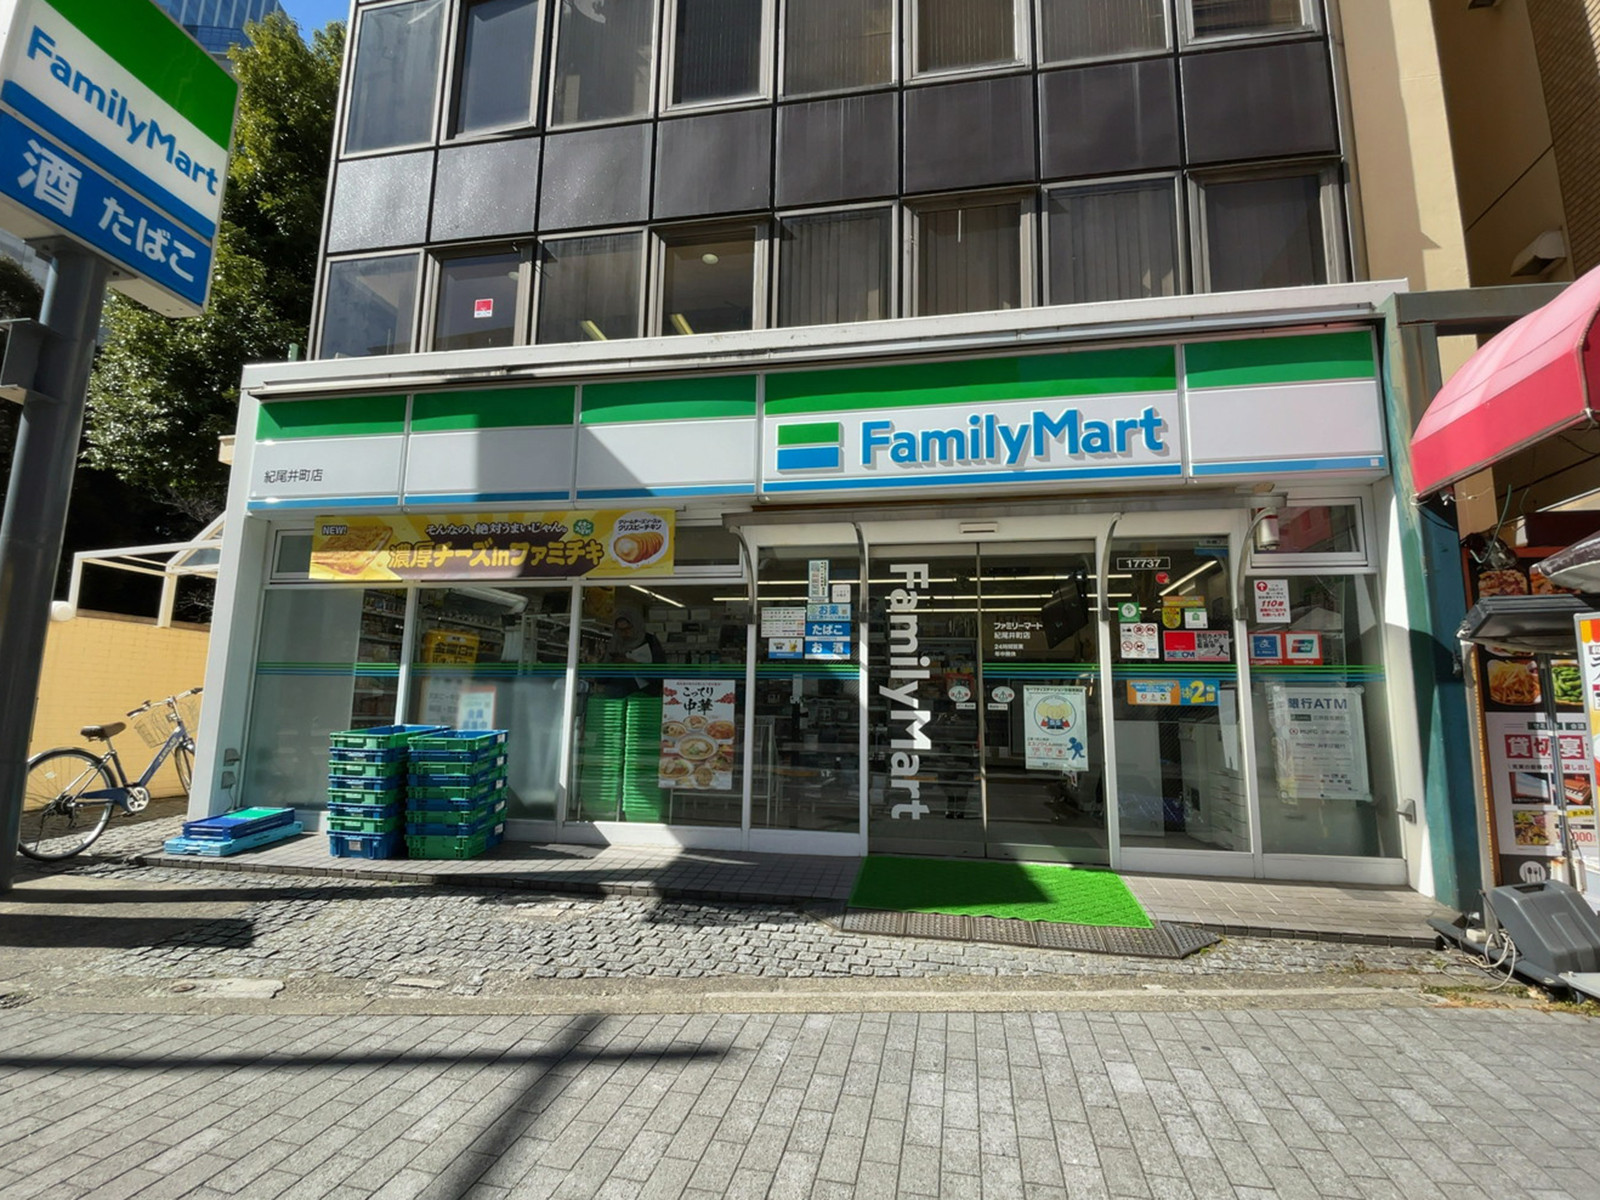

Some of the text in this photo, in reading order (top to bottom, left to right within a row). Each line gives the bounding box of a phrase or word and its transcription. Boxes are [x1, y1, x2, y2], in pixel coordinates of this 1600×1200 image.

[27, 25, 218, 196] FamilyMart
[17, 139, 196, 283] 酒 たばこ
[861, 406, 1165, 466] FamilyMart
[264, 468, 323, 483] 紀尾井町店
[322, 525, 348, 535] NEW!
[426, 521, 568, 536] そんなの、絶対うまいじゃん。
[388, 537, 605, 569] 濃厚チーズinファミチキ
[1126, 559, 1161, 568] 17737
[812, 624, 843, 635] たばこ
[993, 621, 1043, 630] ファミリーマート
[682, 686, 714, 697] こってり
[879, 563, 932, 820] FamilyMart
[683, 698, 714, 715] 中華
